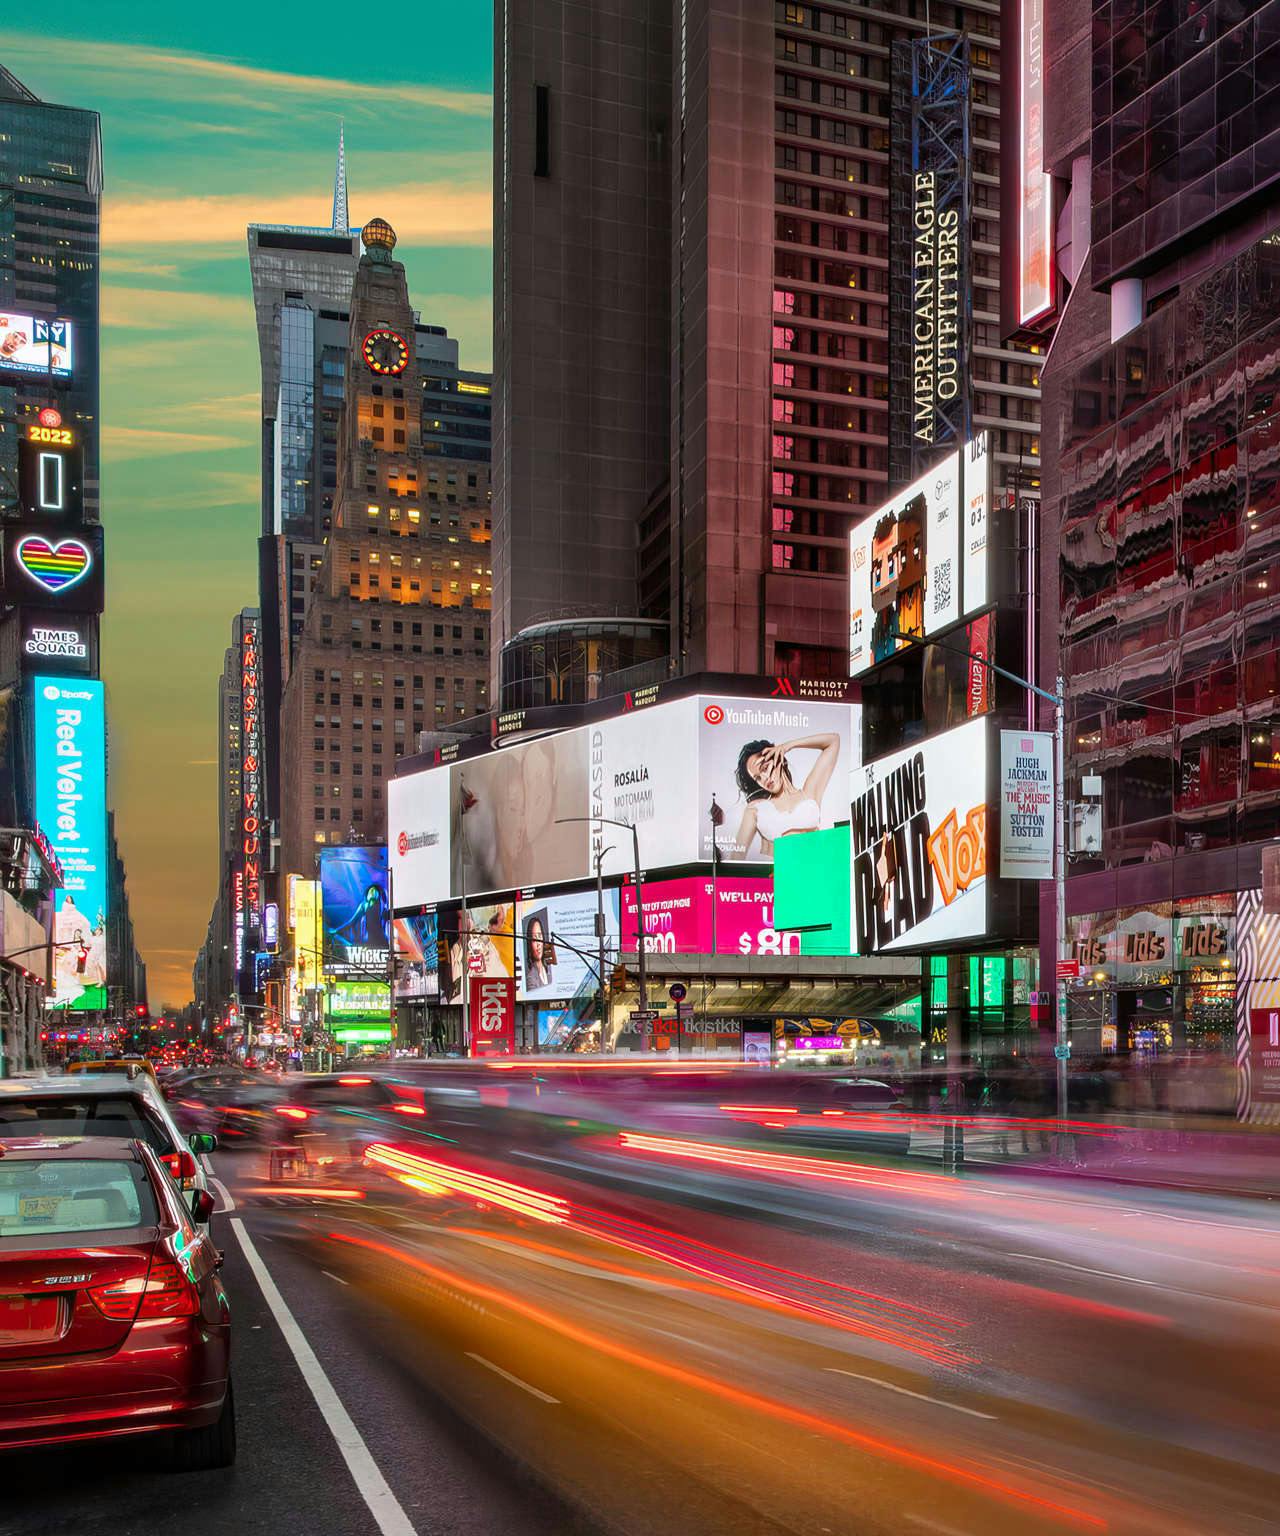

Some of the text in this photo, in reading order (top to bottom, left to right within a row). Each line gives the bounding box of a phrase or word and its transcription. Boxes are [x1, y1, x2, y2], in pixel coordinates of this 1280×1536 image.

[914, 171, 935, 443] AMERICAN EAGLE
[938, 210, 959, 400] OUTFITTERS
[30, 427, 72, 445] 2022
[32, 627, 78, 644] TIMES
[26, 640, 85, 657] SQUARE
[800, 679, 849, 690] MARRIOTT
[800, 688, 843, 699] MARQUIS
[725, 708, 809, 728] YouTube Music
[56, 709, 82, 756] Red
[1016, 757, 1039, 769] HUGH
[614, 764, 649, 788] ROSALÍA
[1008, 769, 1047, 781] JACKMAN
[57, 761, 83, 841] Velvet
[851, 751, 926, 857] WALKING
[1005, 792, 1050, 804] THE MUSIC
[1018, 804, 1038, 815] MAN
[1010, 814, 1045, 826] SUTTON
[1011, 826, 1043, 838] FOSTER
[854, 811, 934, 956] DEAD
[719, 892, 774, 903] WE'LL PAY
[645, 912, 672, 932] UP TO
[346, 946, 400, 963] WICKE
[482, 982, 507, 1032] tkts
